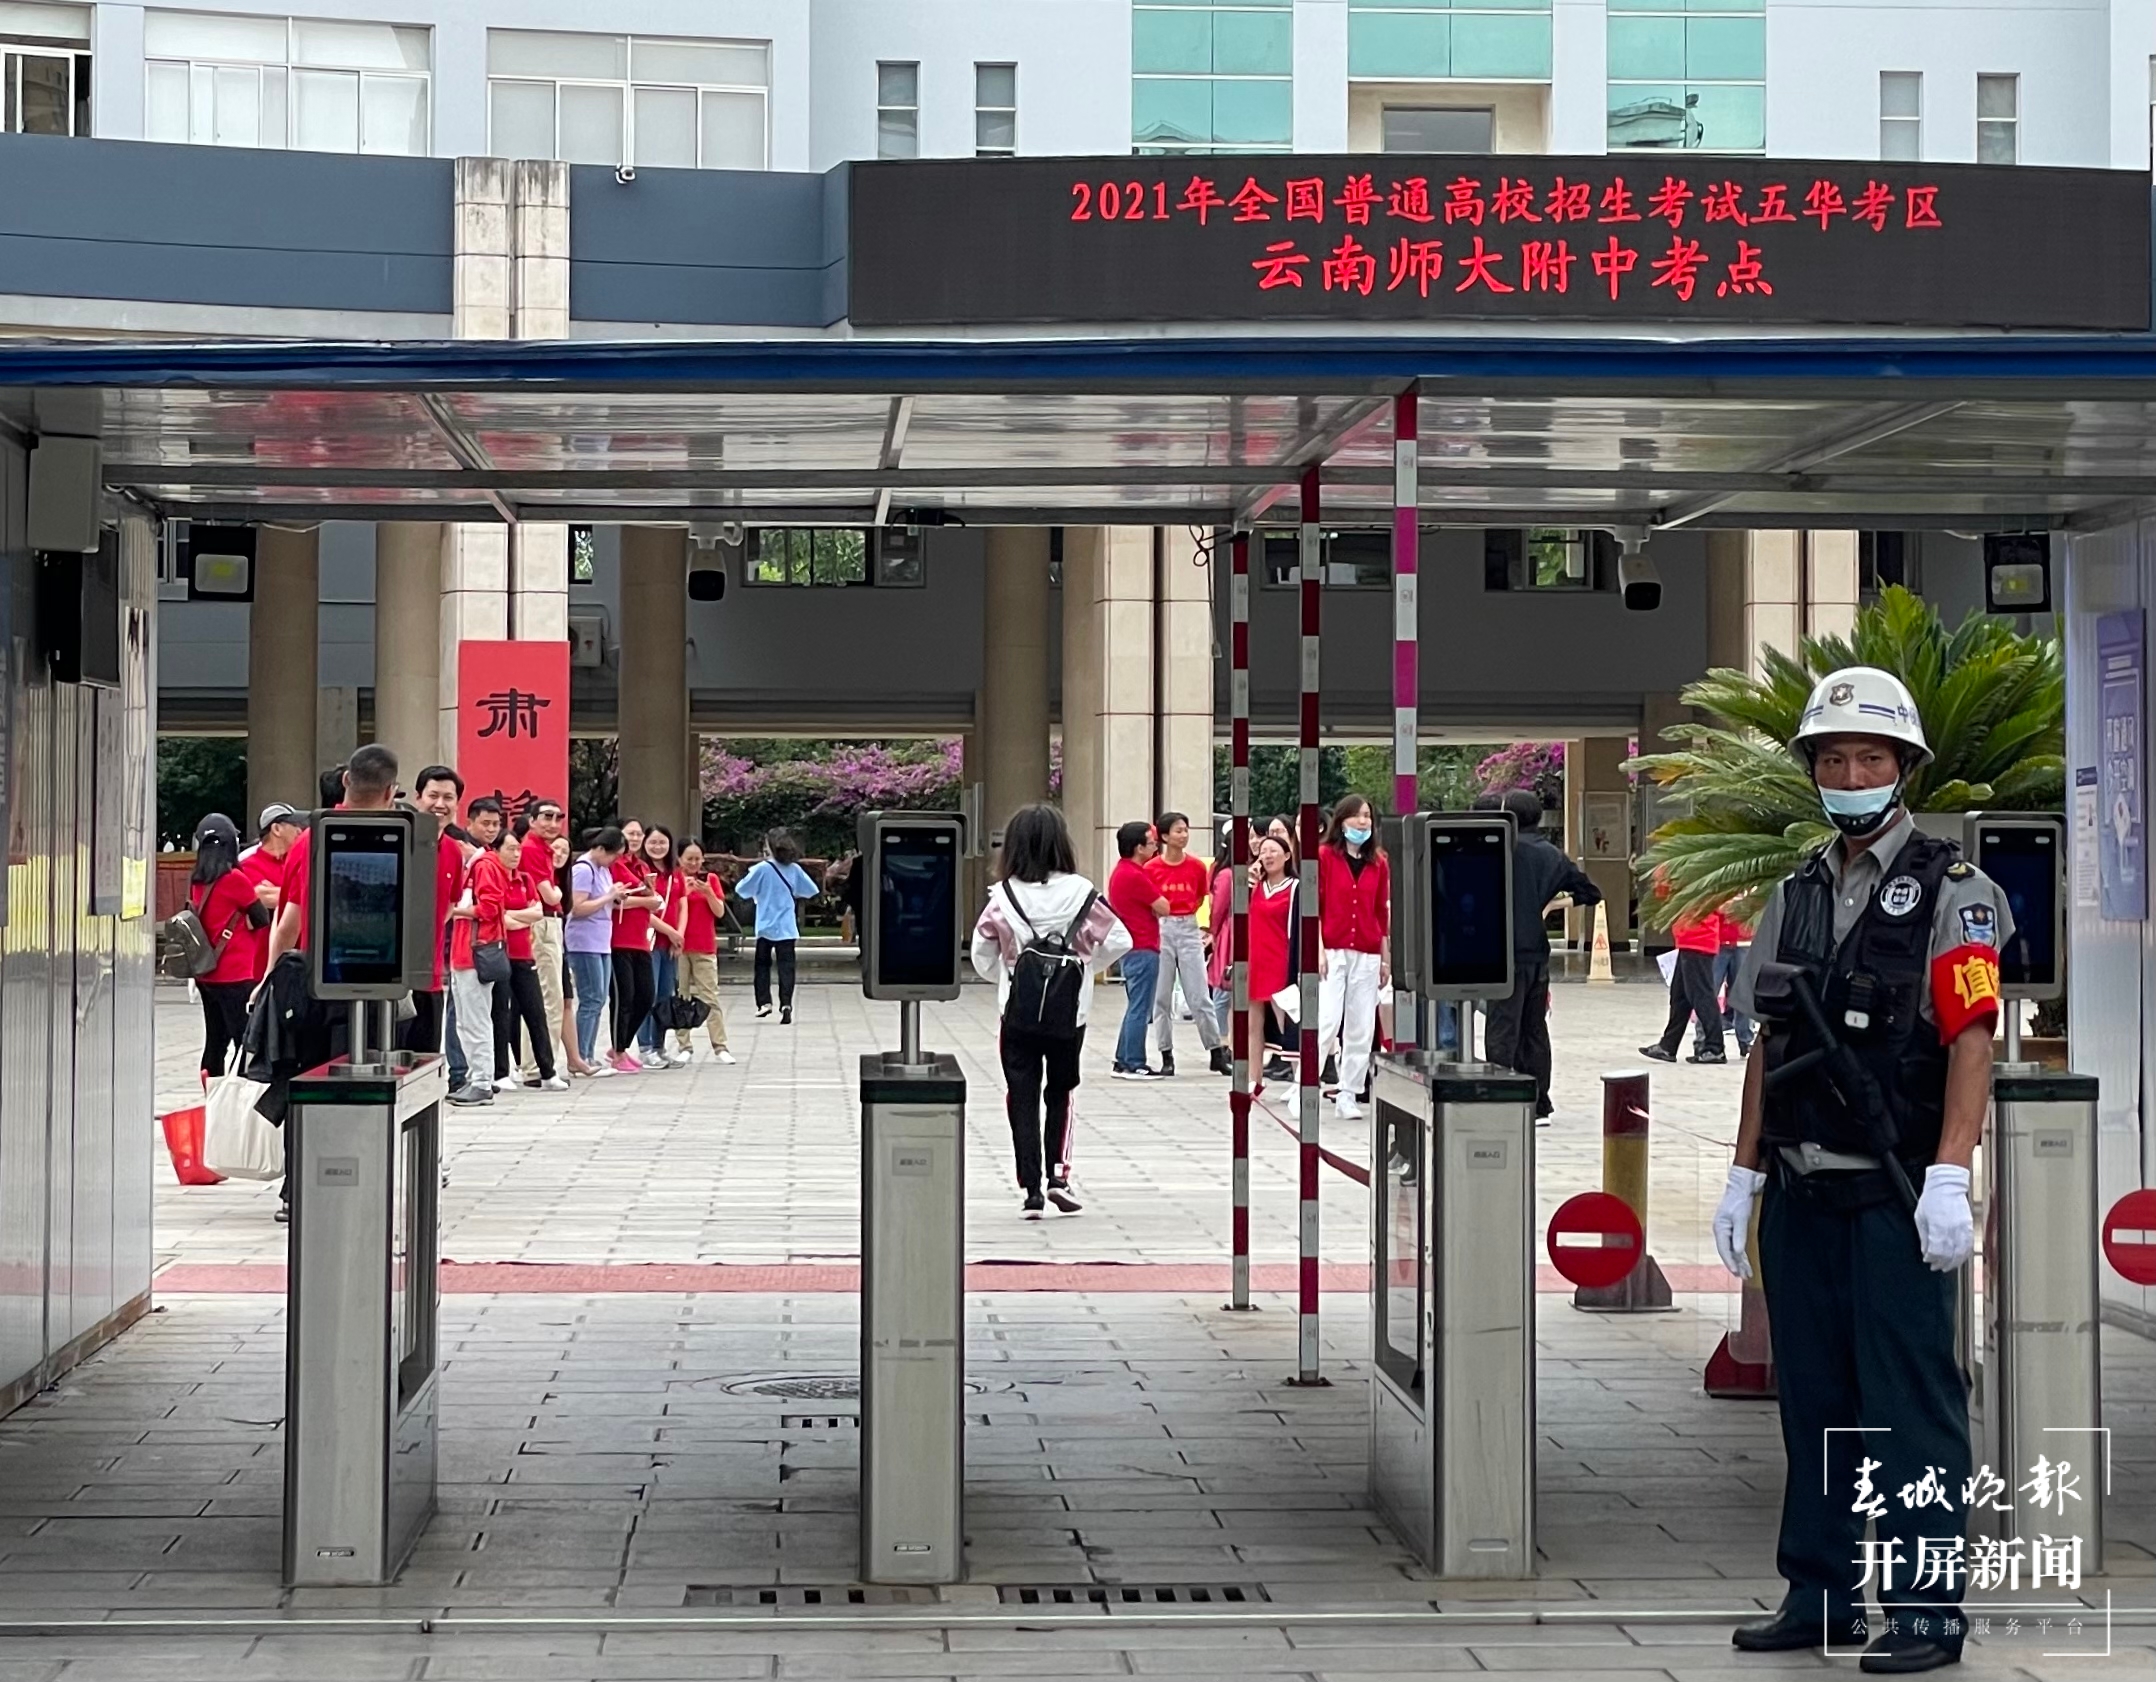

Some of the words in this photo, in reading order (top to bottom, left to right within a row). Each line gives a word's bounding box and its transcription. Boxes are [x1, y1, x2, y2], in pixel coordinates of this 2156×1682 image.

[1071, 175, 1941, 231] 2021年全国普通高校招生考试五华考区
[1252, 235, 1773, 301] 云南师大附中考点
